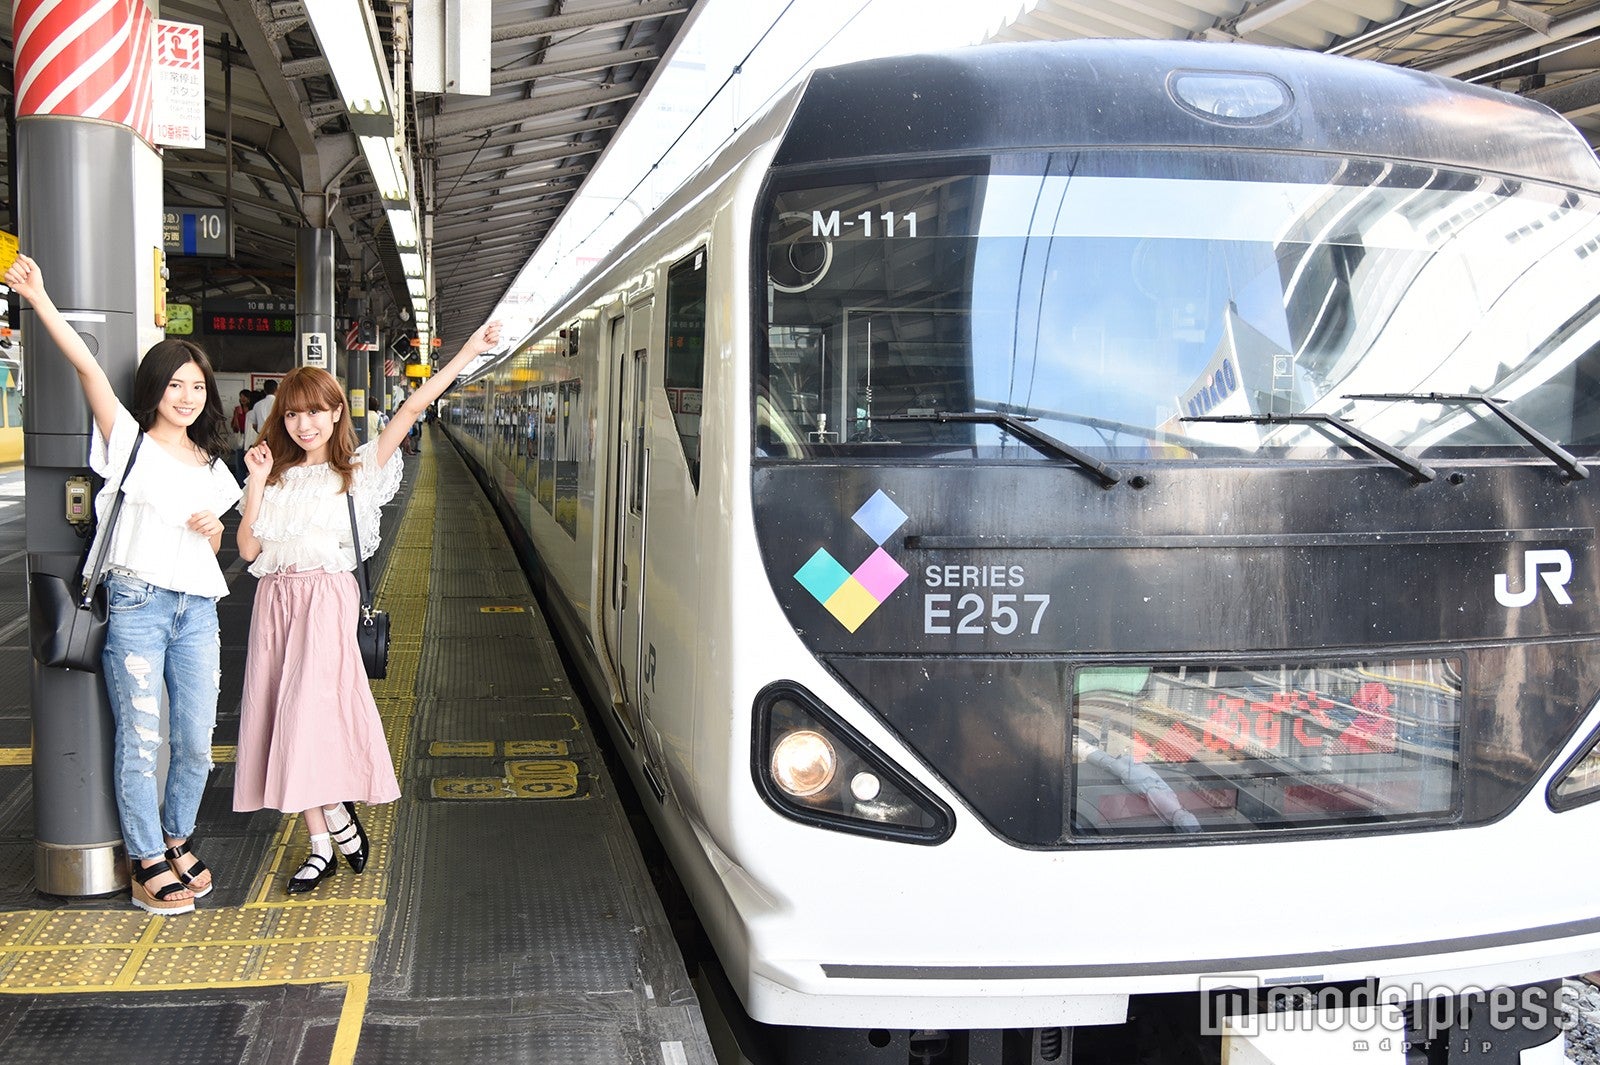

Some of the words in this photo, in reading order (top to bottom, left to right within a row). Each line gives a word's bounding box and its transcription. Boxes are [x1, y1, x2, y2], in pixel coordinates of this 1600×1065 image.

[169, 86, 200, 98] ボタン
[200, 214, 221, 239] 10
[812, 210, 917, 238] M-111
[925, 565, 1025, 587] SERIES
[1494, 549, 1573, 608] JR
[924, 593, 1051, 635] E257
[644, 642, 657, 693] JR
